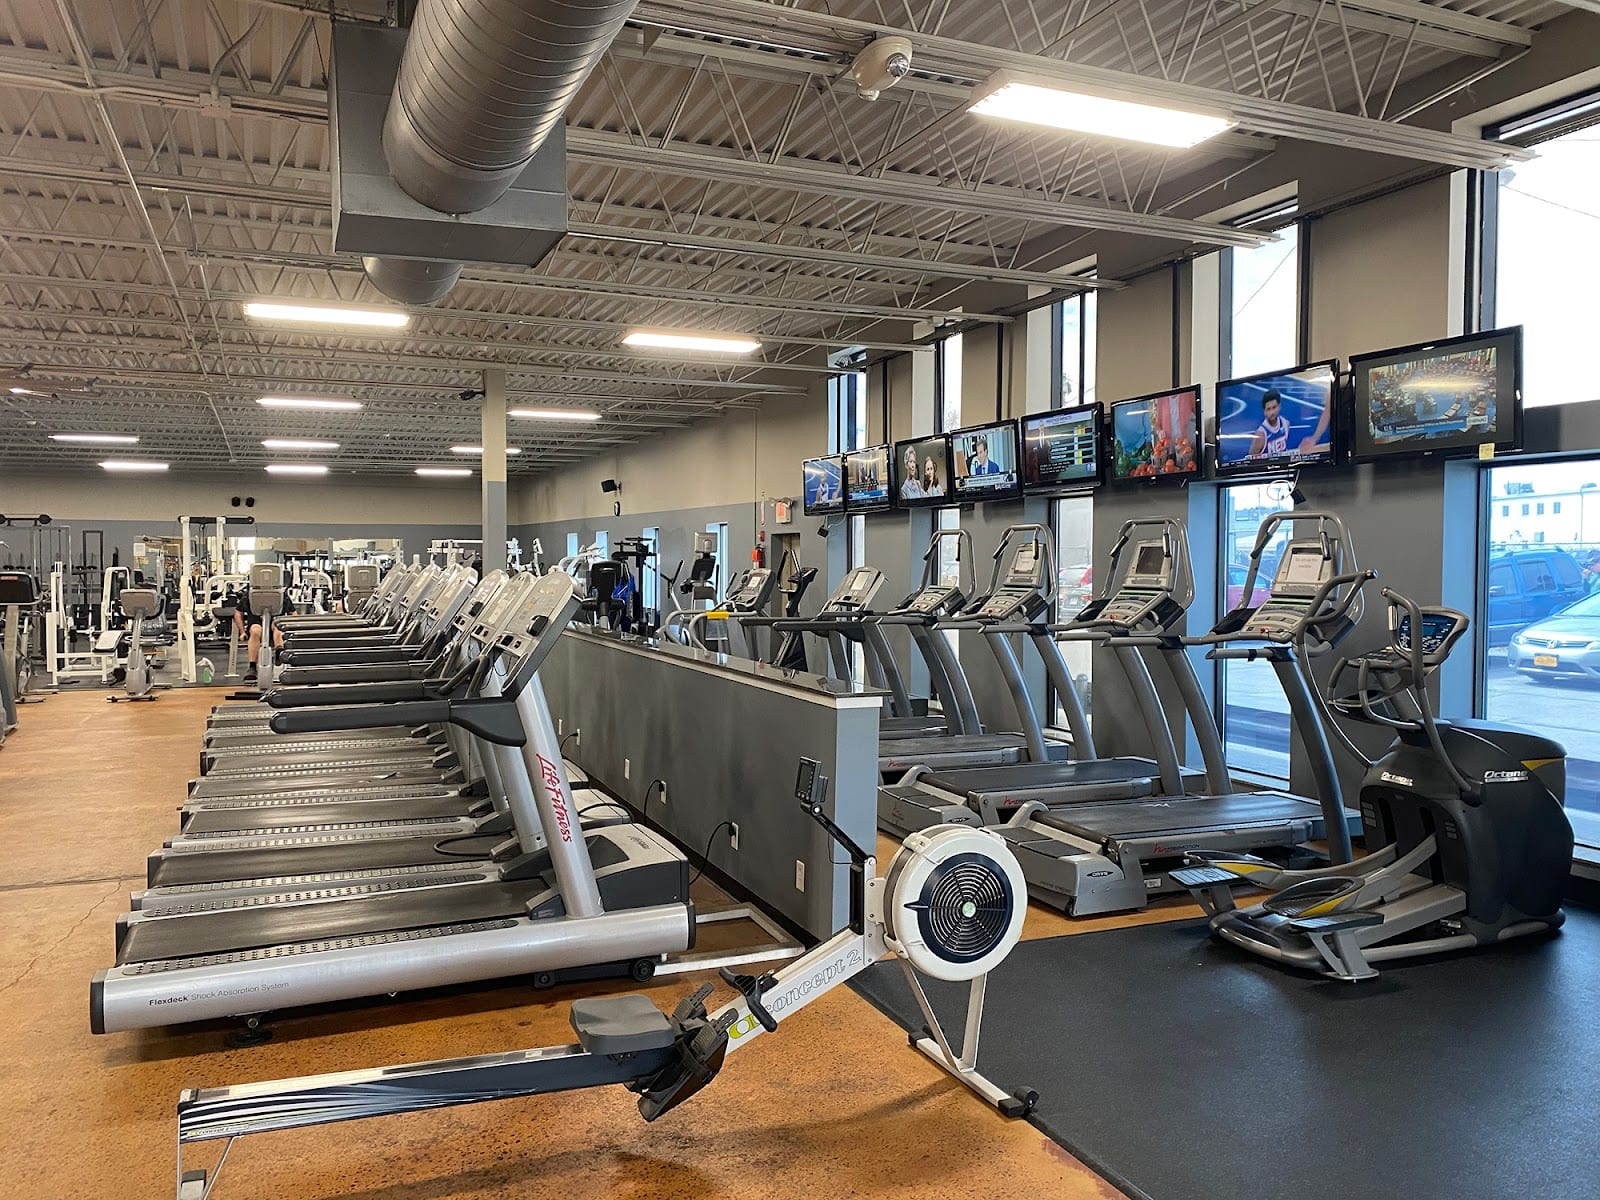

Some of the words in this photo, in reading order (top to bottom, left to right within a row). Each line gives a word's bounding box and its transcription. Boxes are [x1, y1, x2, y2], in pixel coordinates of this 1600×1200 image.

[1484, 770, 1528, 778] Octane
[846, 949, 862, 966] 2
[149, 995, 189, 1006] Flexdeck
[191, 992, 216, 1001] Shock
[218, 986, 259, 997] Absorption
[261, 982, 290, 993] System
